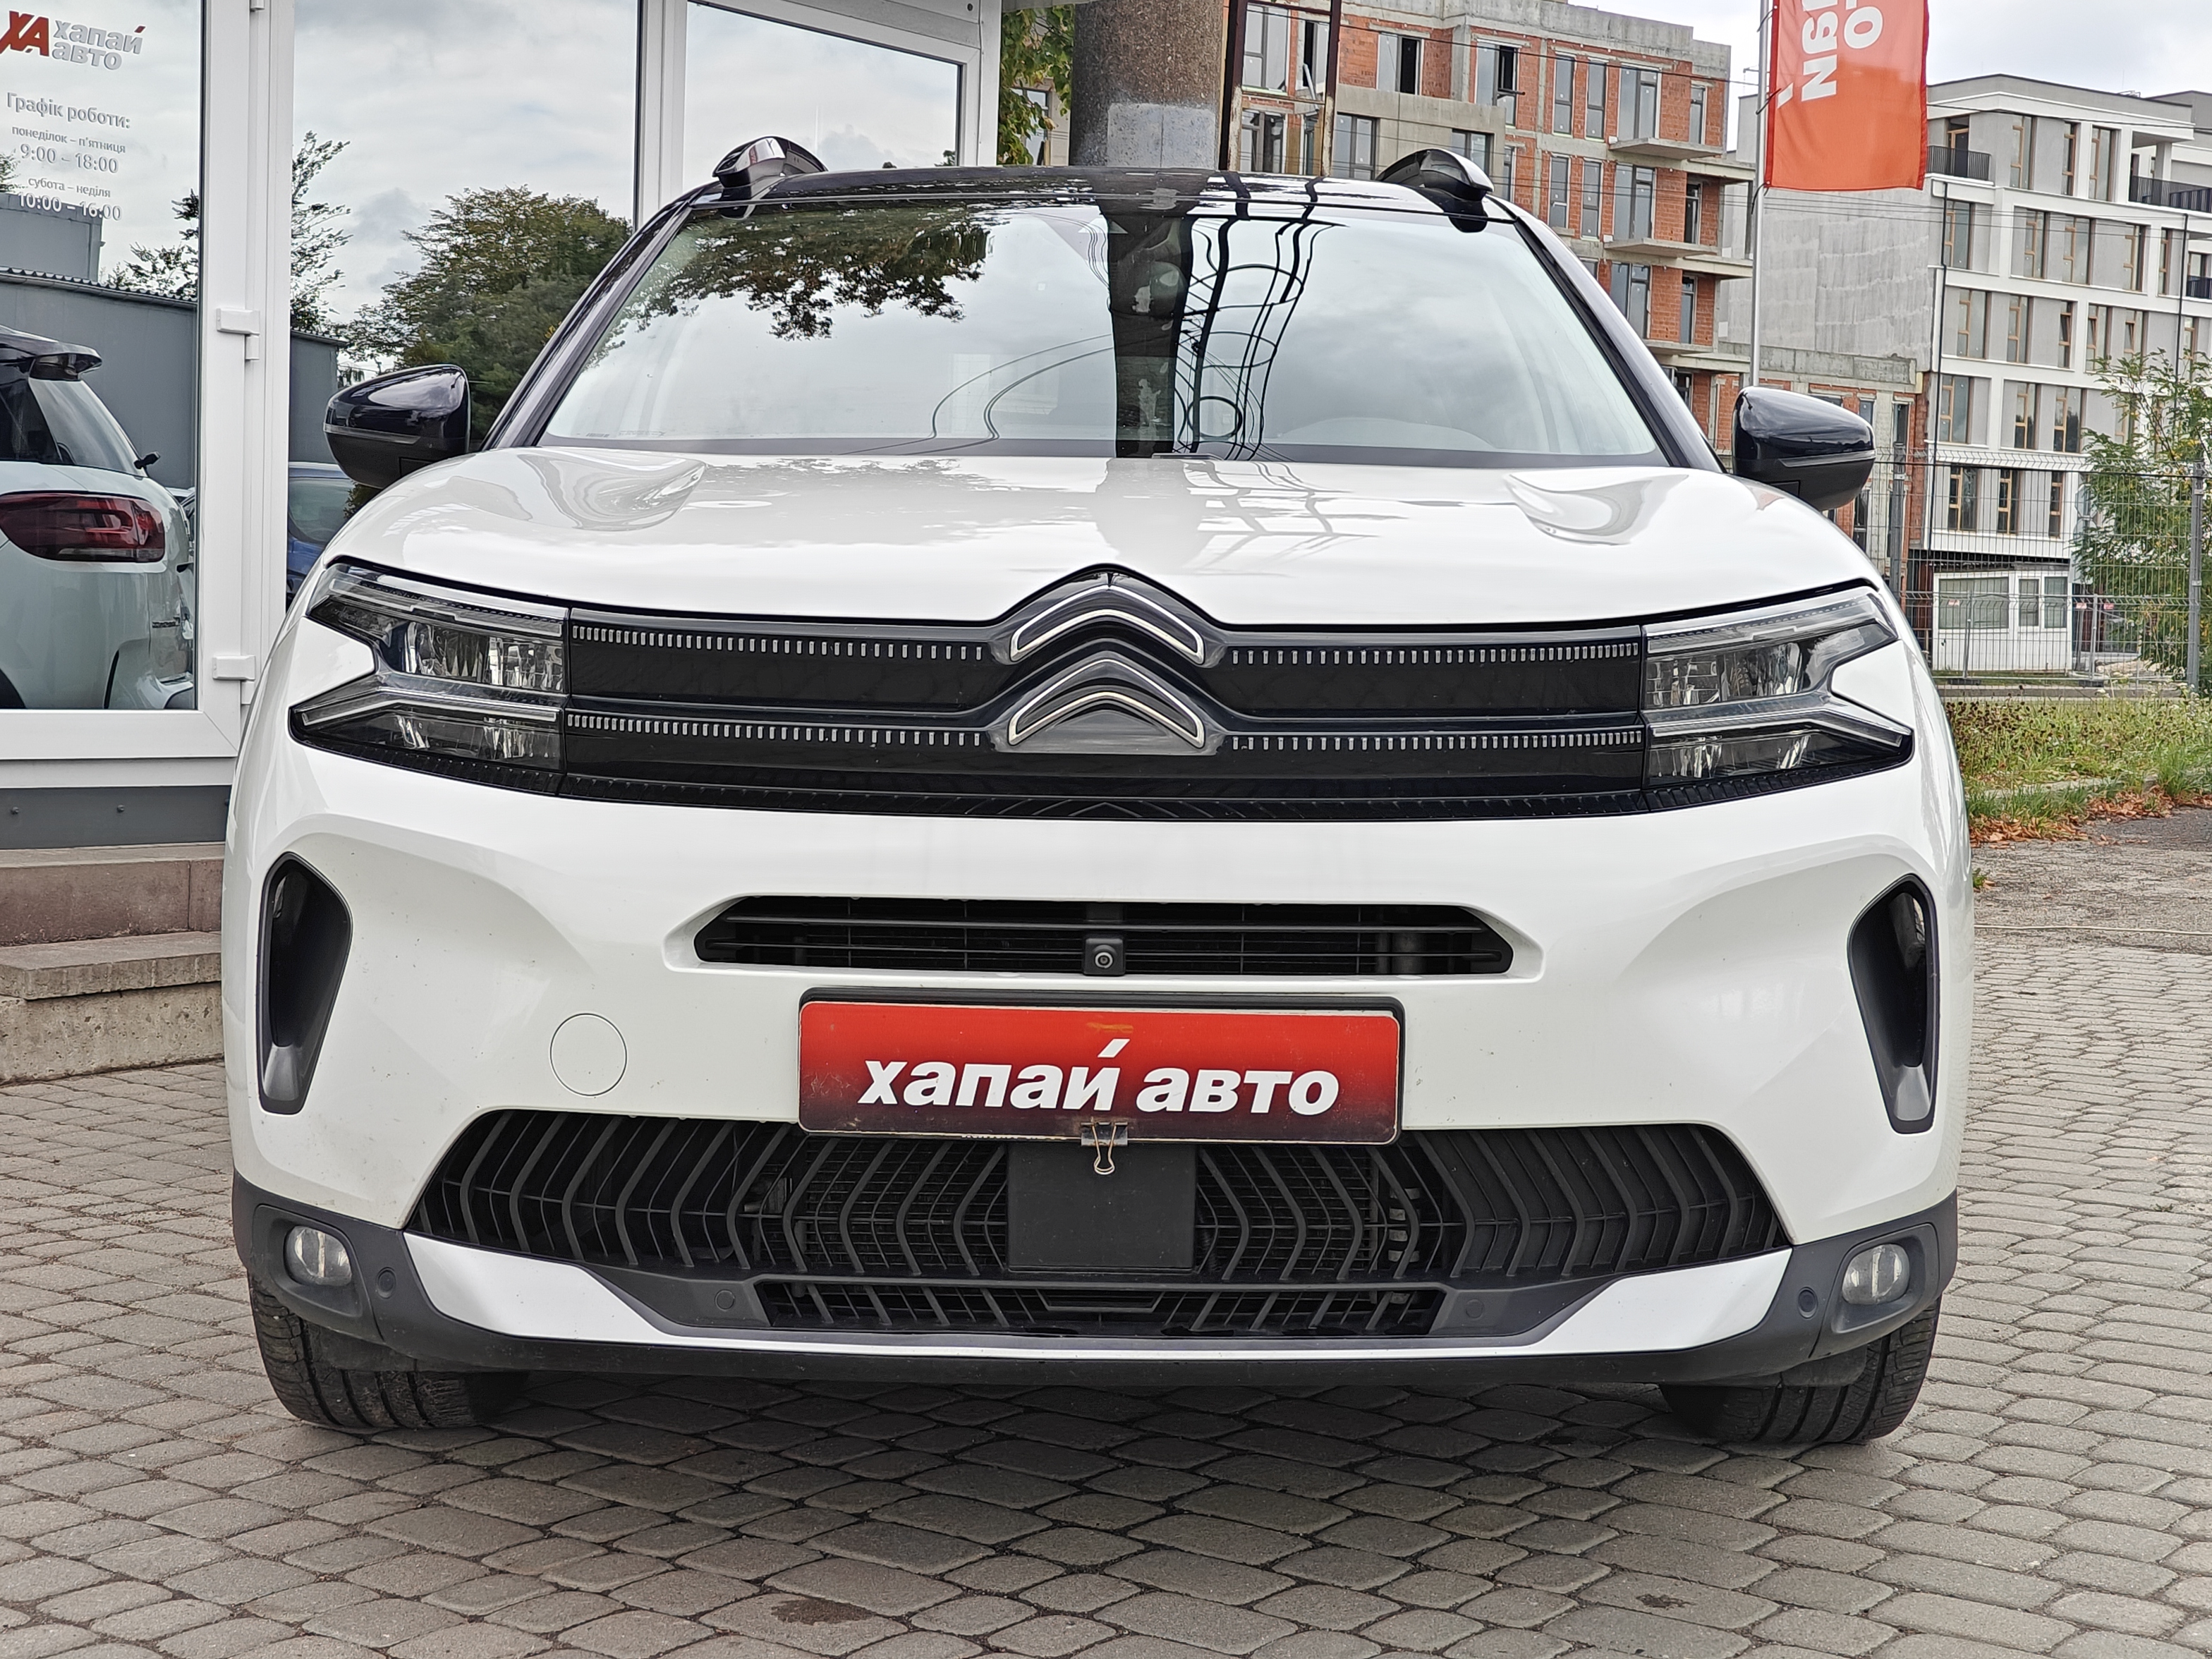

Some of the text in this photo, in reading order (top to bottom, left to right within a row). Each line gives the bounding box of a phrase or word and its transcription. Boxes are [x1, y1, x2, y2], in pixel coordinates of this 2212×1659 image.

[53, 20, 146, 55] хапай
[51, 41, 123, 71] авто
[7, 92, 130, 129] Графік роботи:
[12, 126, 68, 144] понеділок
[20, 143, 57, 164] 9:00
[75, 152, 119, 174] 18:00
[28, 178, 66, 191] субота
[75, 185, 111, 198] неділя
[18, 192, 62, 212] 10:00
[80, 200, 123, 221] 16:00
[857, 1038, 1339, 1116] хапай авто
